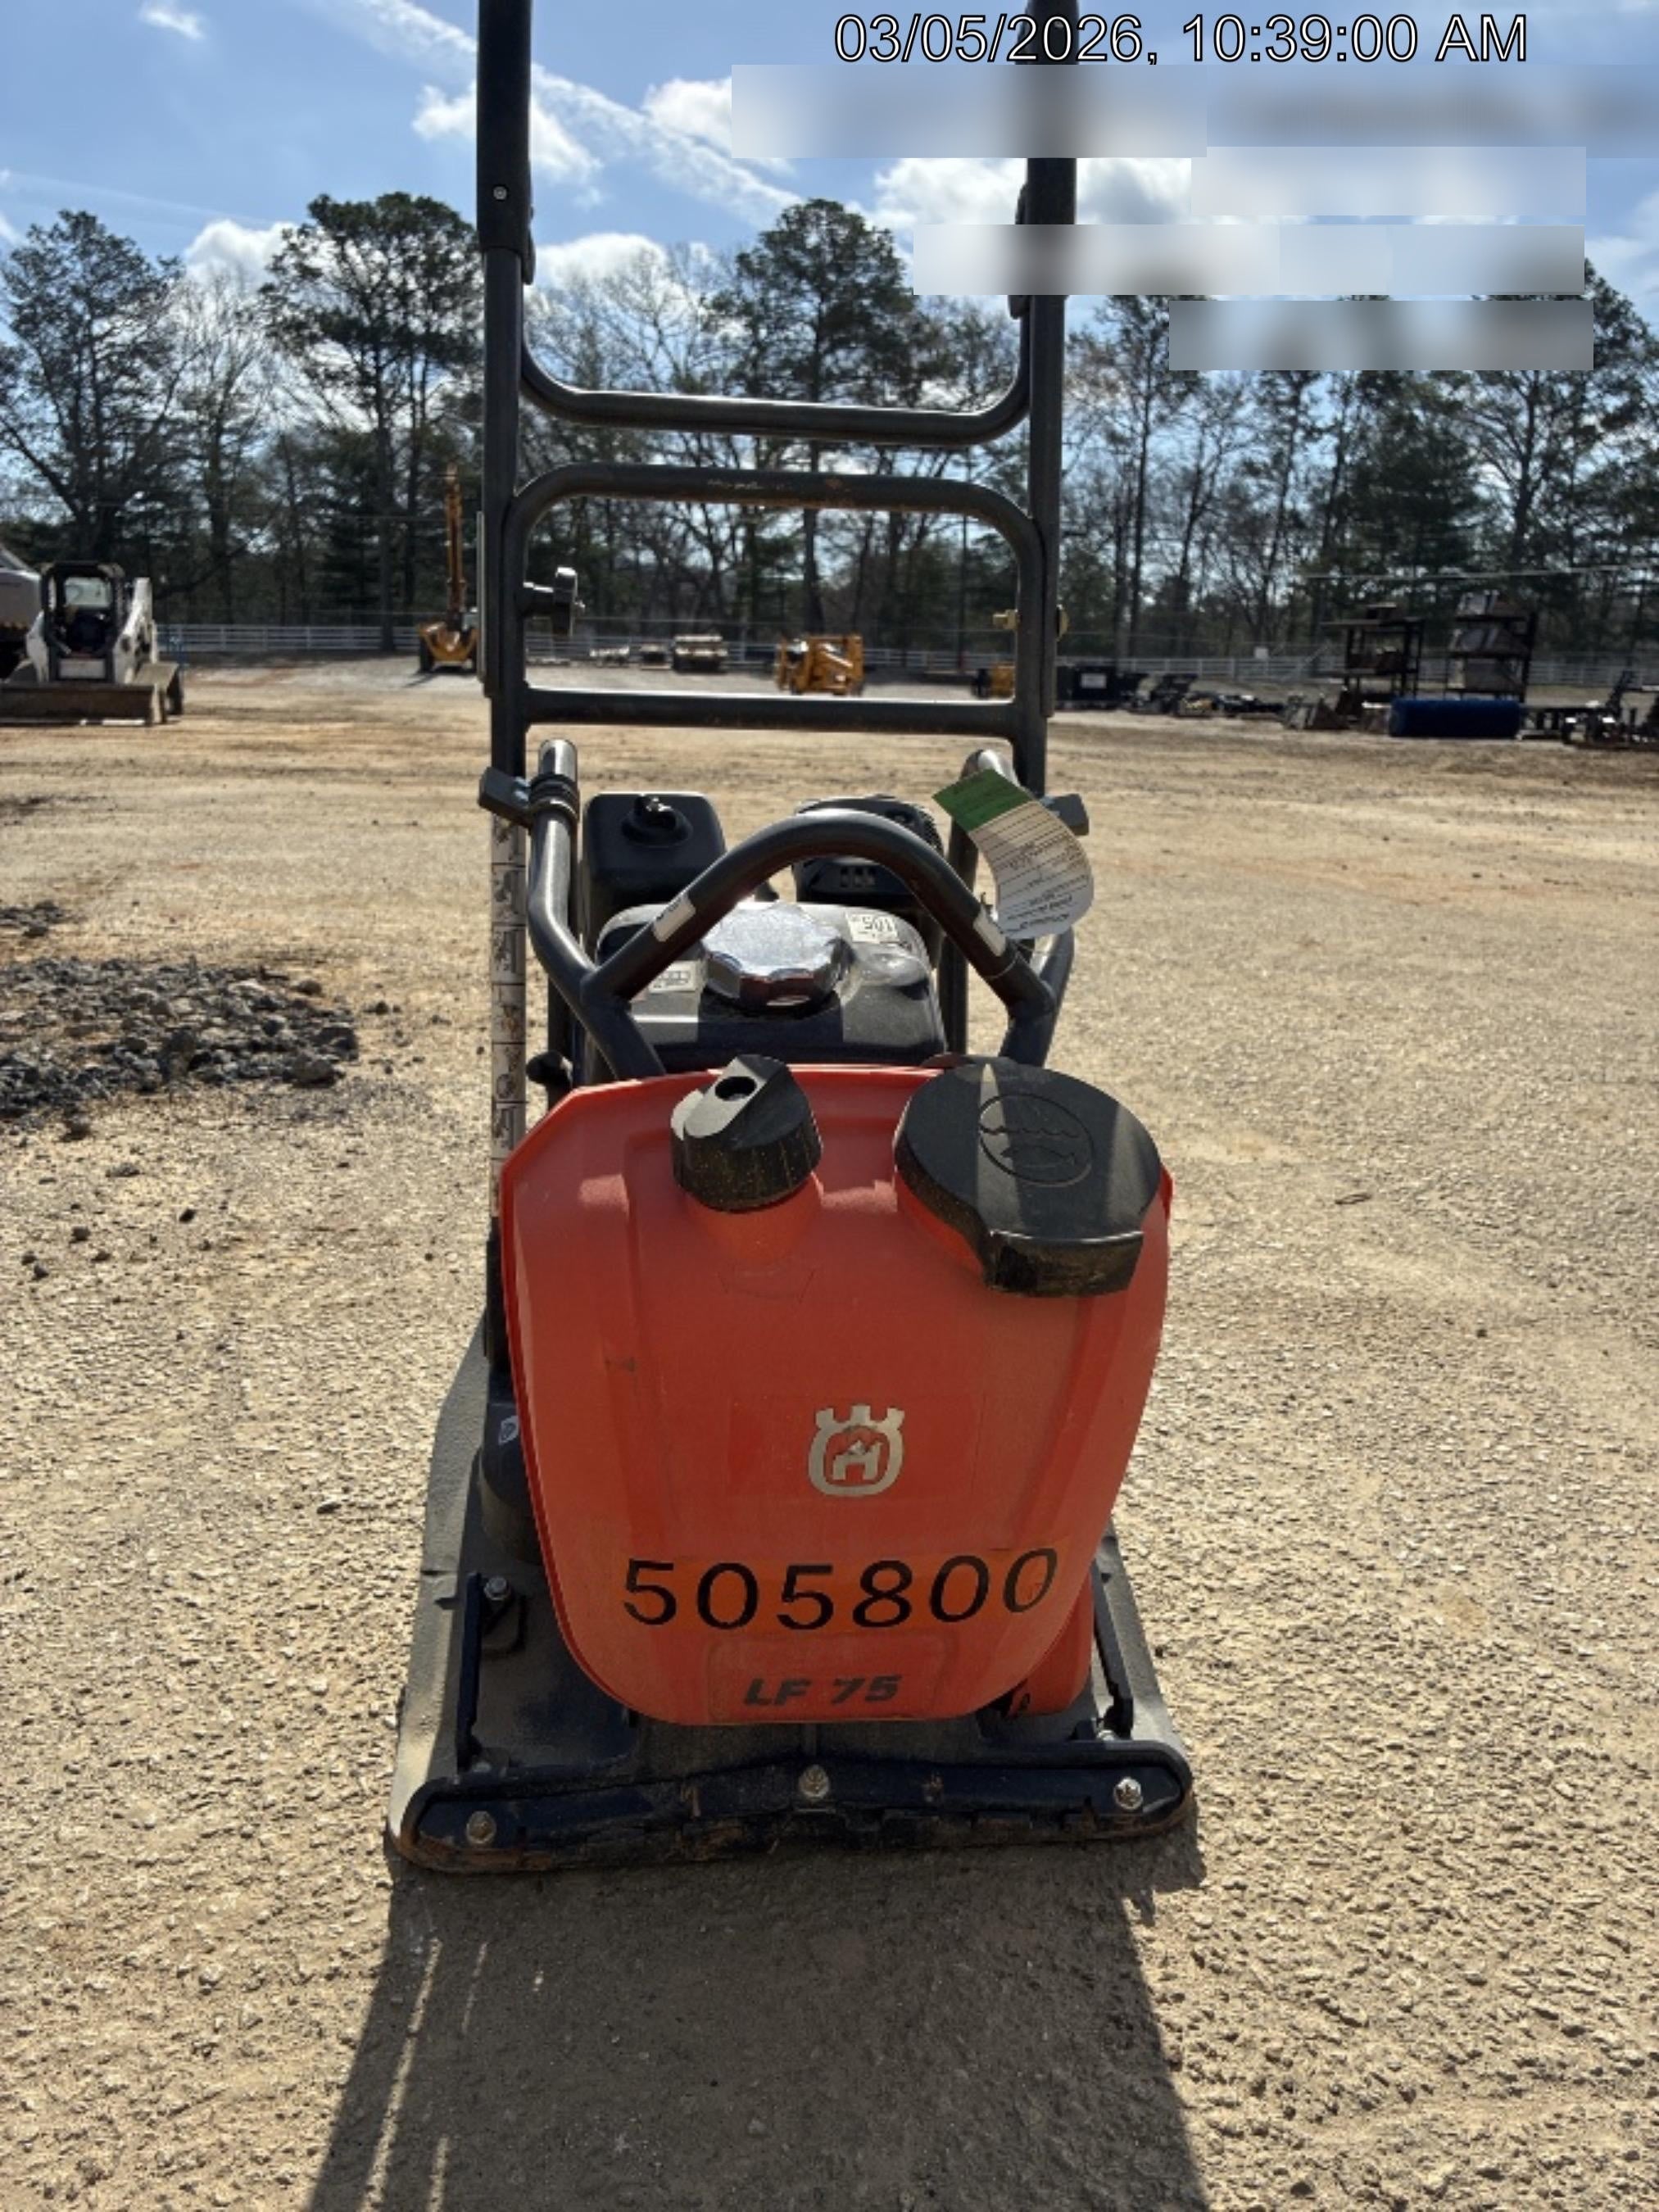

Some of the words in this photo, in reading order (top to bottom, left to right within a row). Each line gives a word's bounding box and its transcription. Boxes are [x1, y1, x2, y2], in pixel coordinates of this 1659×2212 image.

[623, 1548, 1058, 1630] 505800
[743, 1677, 811, 1706] LF
[830, 1674, 900, 1705] 75
